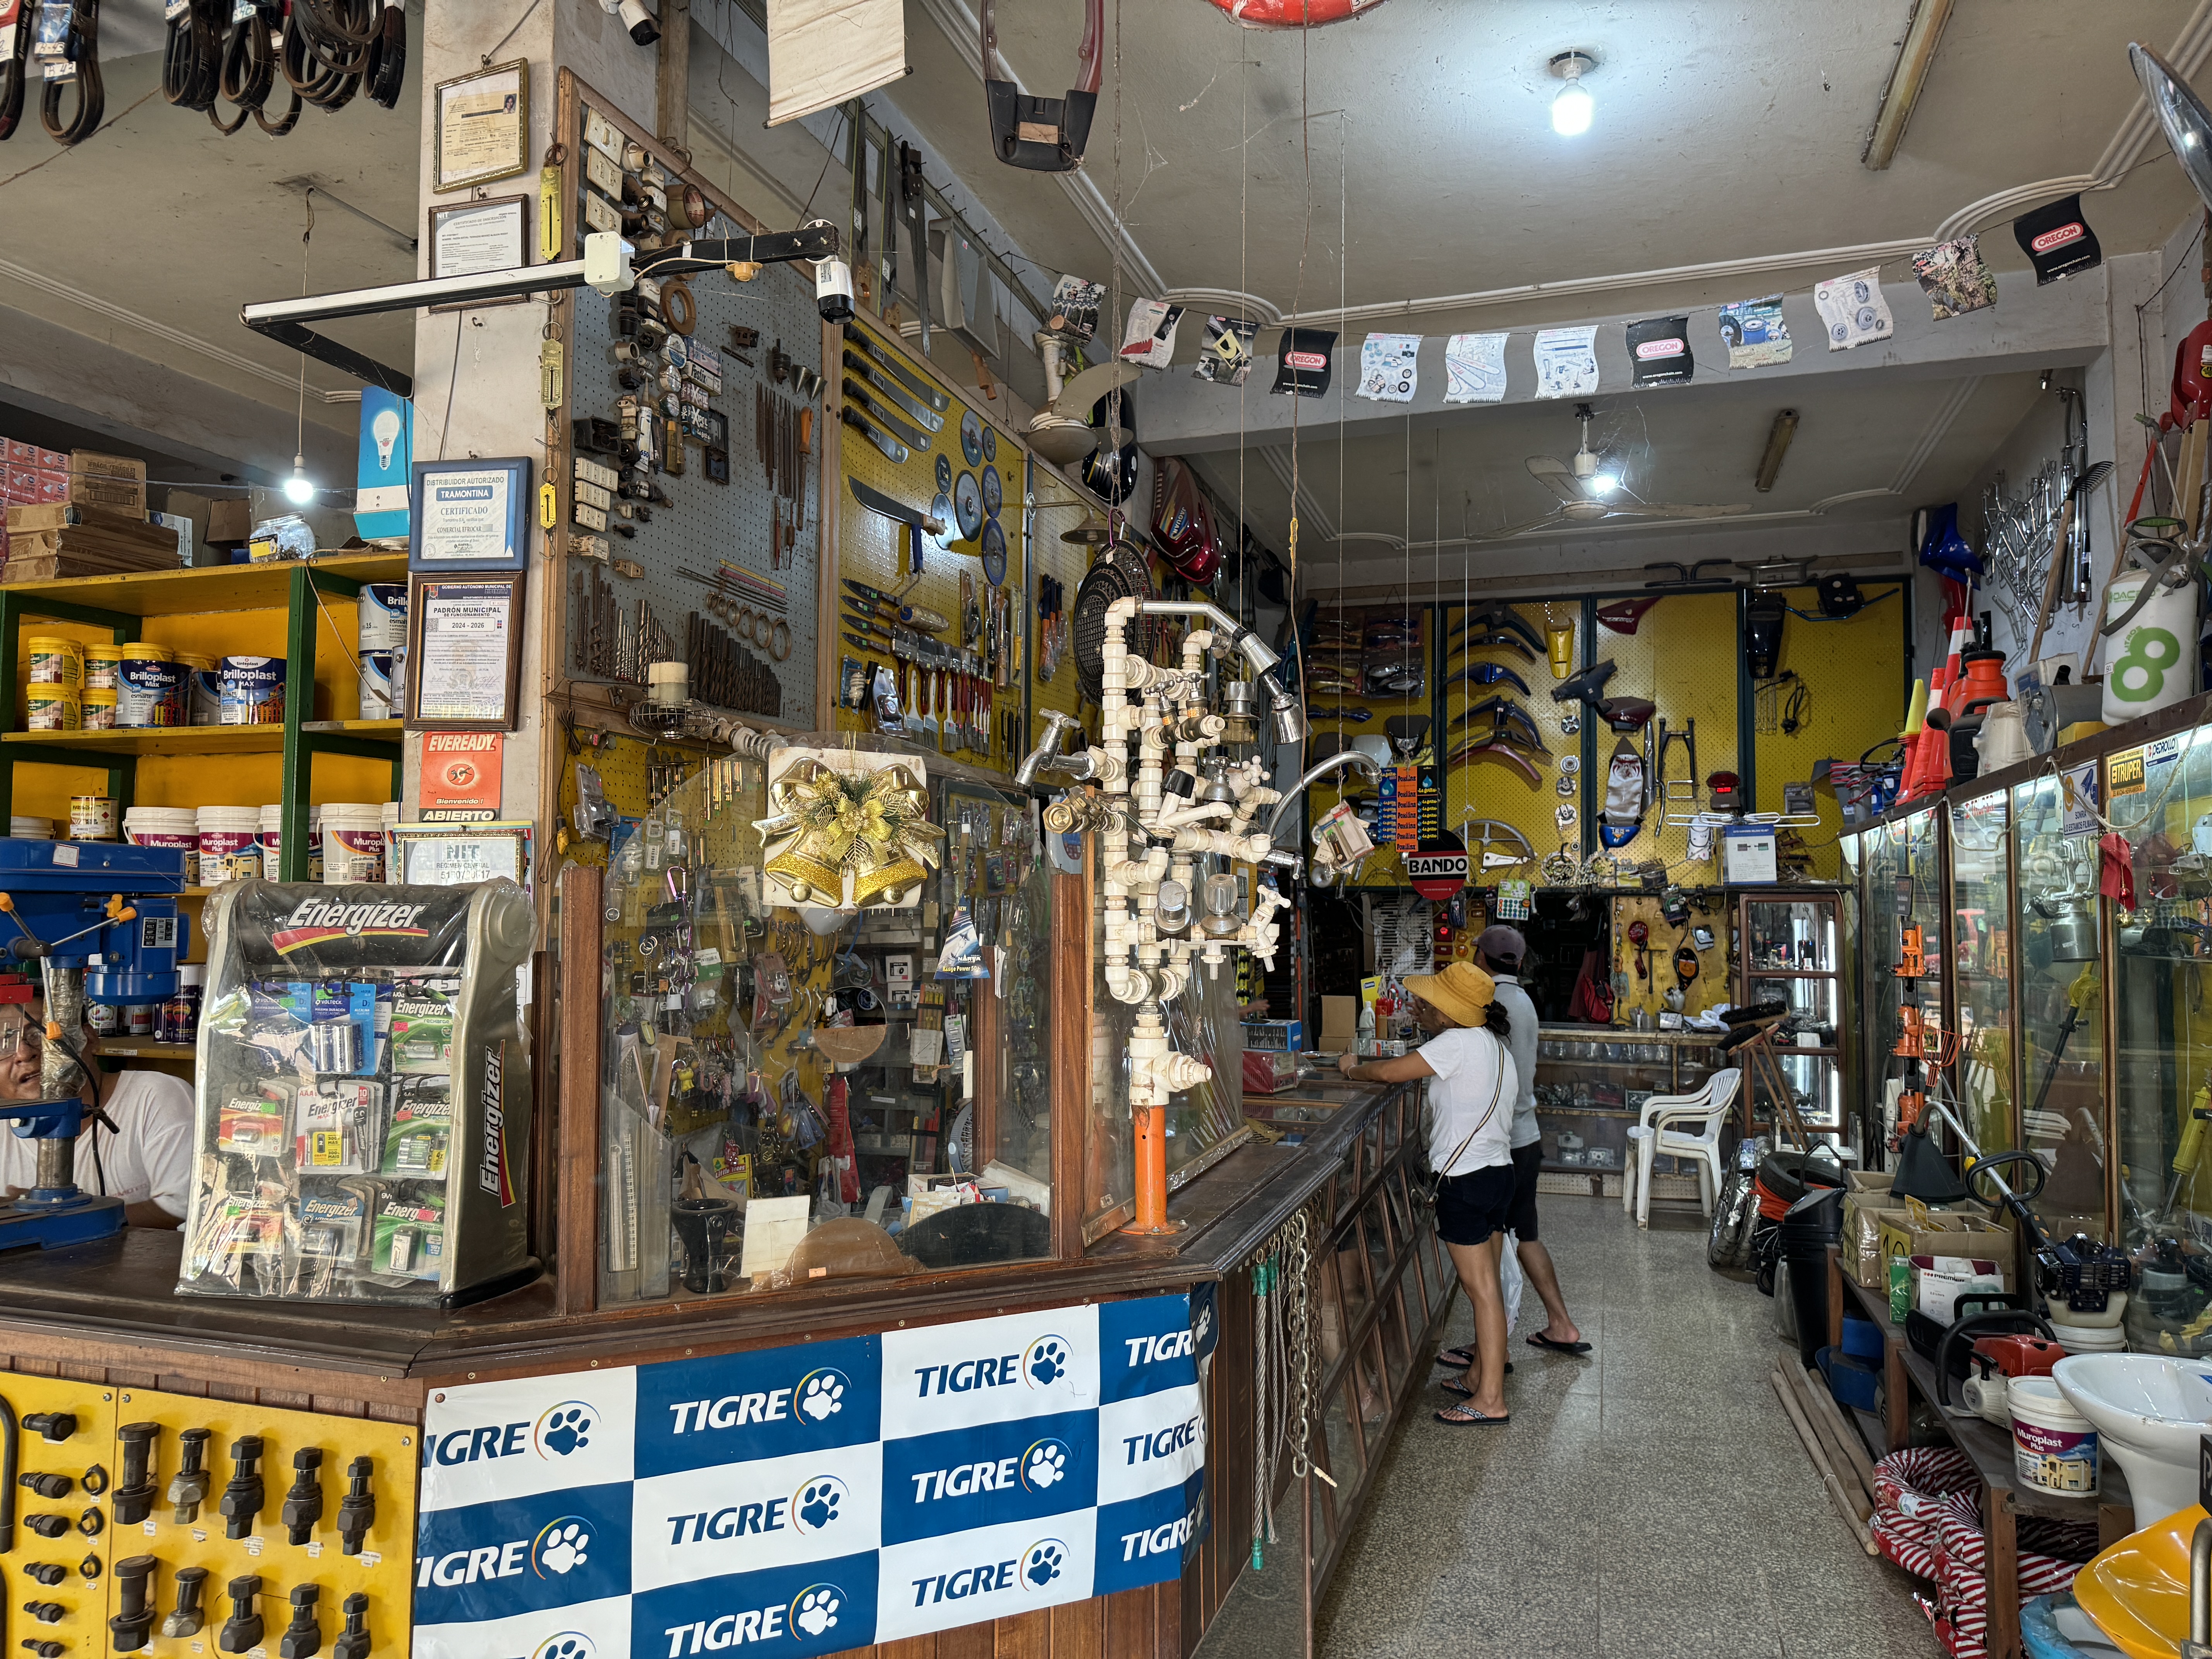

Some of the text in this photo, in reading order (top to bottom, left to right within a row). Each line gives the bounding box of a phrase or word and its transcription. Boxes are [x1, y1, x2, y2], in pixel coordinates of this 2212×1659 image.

[2037, 226, 2078, 247] OREGON
[1642, 342, 1678, 353] OREGON
[1290, 355, 1321, 364] OREGON
[692, 364, 706, 385] Fastix
[441, 489, 489, 499] TRAMONTINA
[441, 507, 488, 515] CERTIFICADO
[2111, 627, 2180, 702] 8
[130, 672, 176, 683] Brilloplast
[223, 670, 276, 681] Brilloplast
[422, 811, 495, 821] ABIERTO
[2069, 821, 2082, 831] ESTAMOS
[202, 838, 238, 846] Muroplast
[354, 838, 385, 847] Muropla
[447, 845, 480, 859] NIT
[1409, 858, 1467, 873] BANDO
[287, 897, 431, 935] Energizer
[958, 953, 981, 963] NARVA
[395, 1000, 446, 1018] Energizer
[228, 1098, 261, 1112] Energiz
[307, 1097, 357, 1117] Energizer
[480, 1045, 503, 1195] Energizer
[716, 1168, 729, 1178] Little
[304, 1200, 358, 1217] Energizer
[383, 1202, 442, 1222] Energr
[1125, 1329, 1195, 1367] TIGR
[914, 1354, 1020, 1398] TIGRE
[669, 1388, 791, 1435] TIGRE
[422, 1421, 531, 1468] IGRE
[1123, 1415, 1199, 1465] TIGRE
[2017, 1427, 2063, 1448] Muroplast
[2031, 1442, 2044, 1451] Plus
[911, 1457, 1018, 1503] TIGRE
[666, 1496, 788, 1546] TIGRE
[1120, 1506, 1195, 1561] TIGRE
[416, 1539, 529, 1587] IGRE
[911, 1559, 1017, 1607] TIGRE
[664, 1604, 786, 1659] TIGRE
